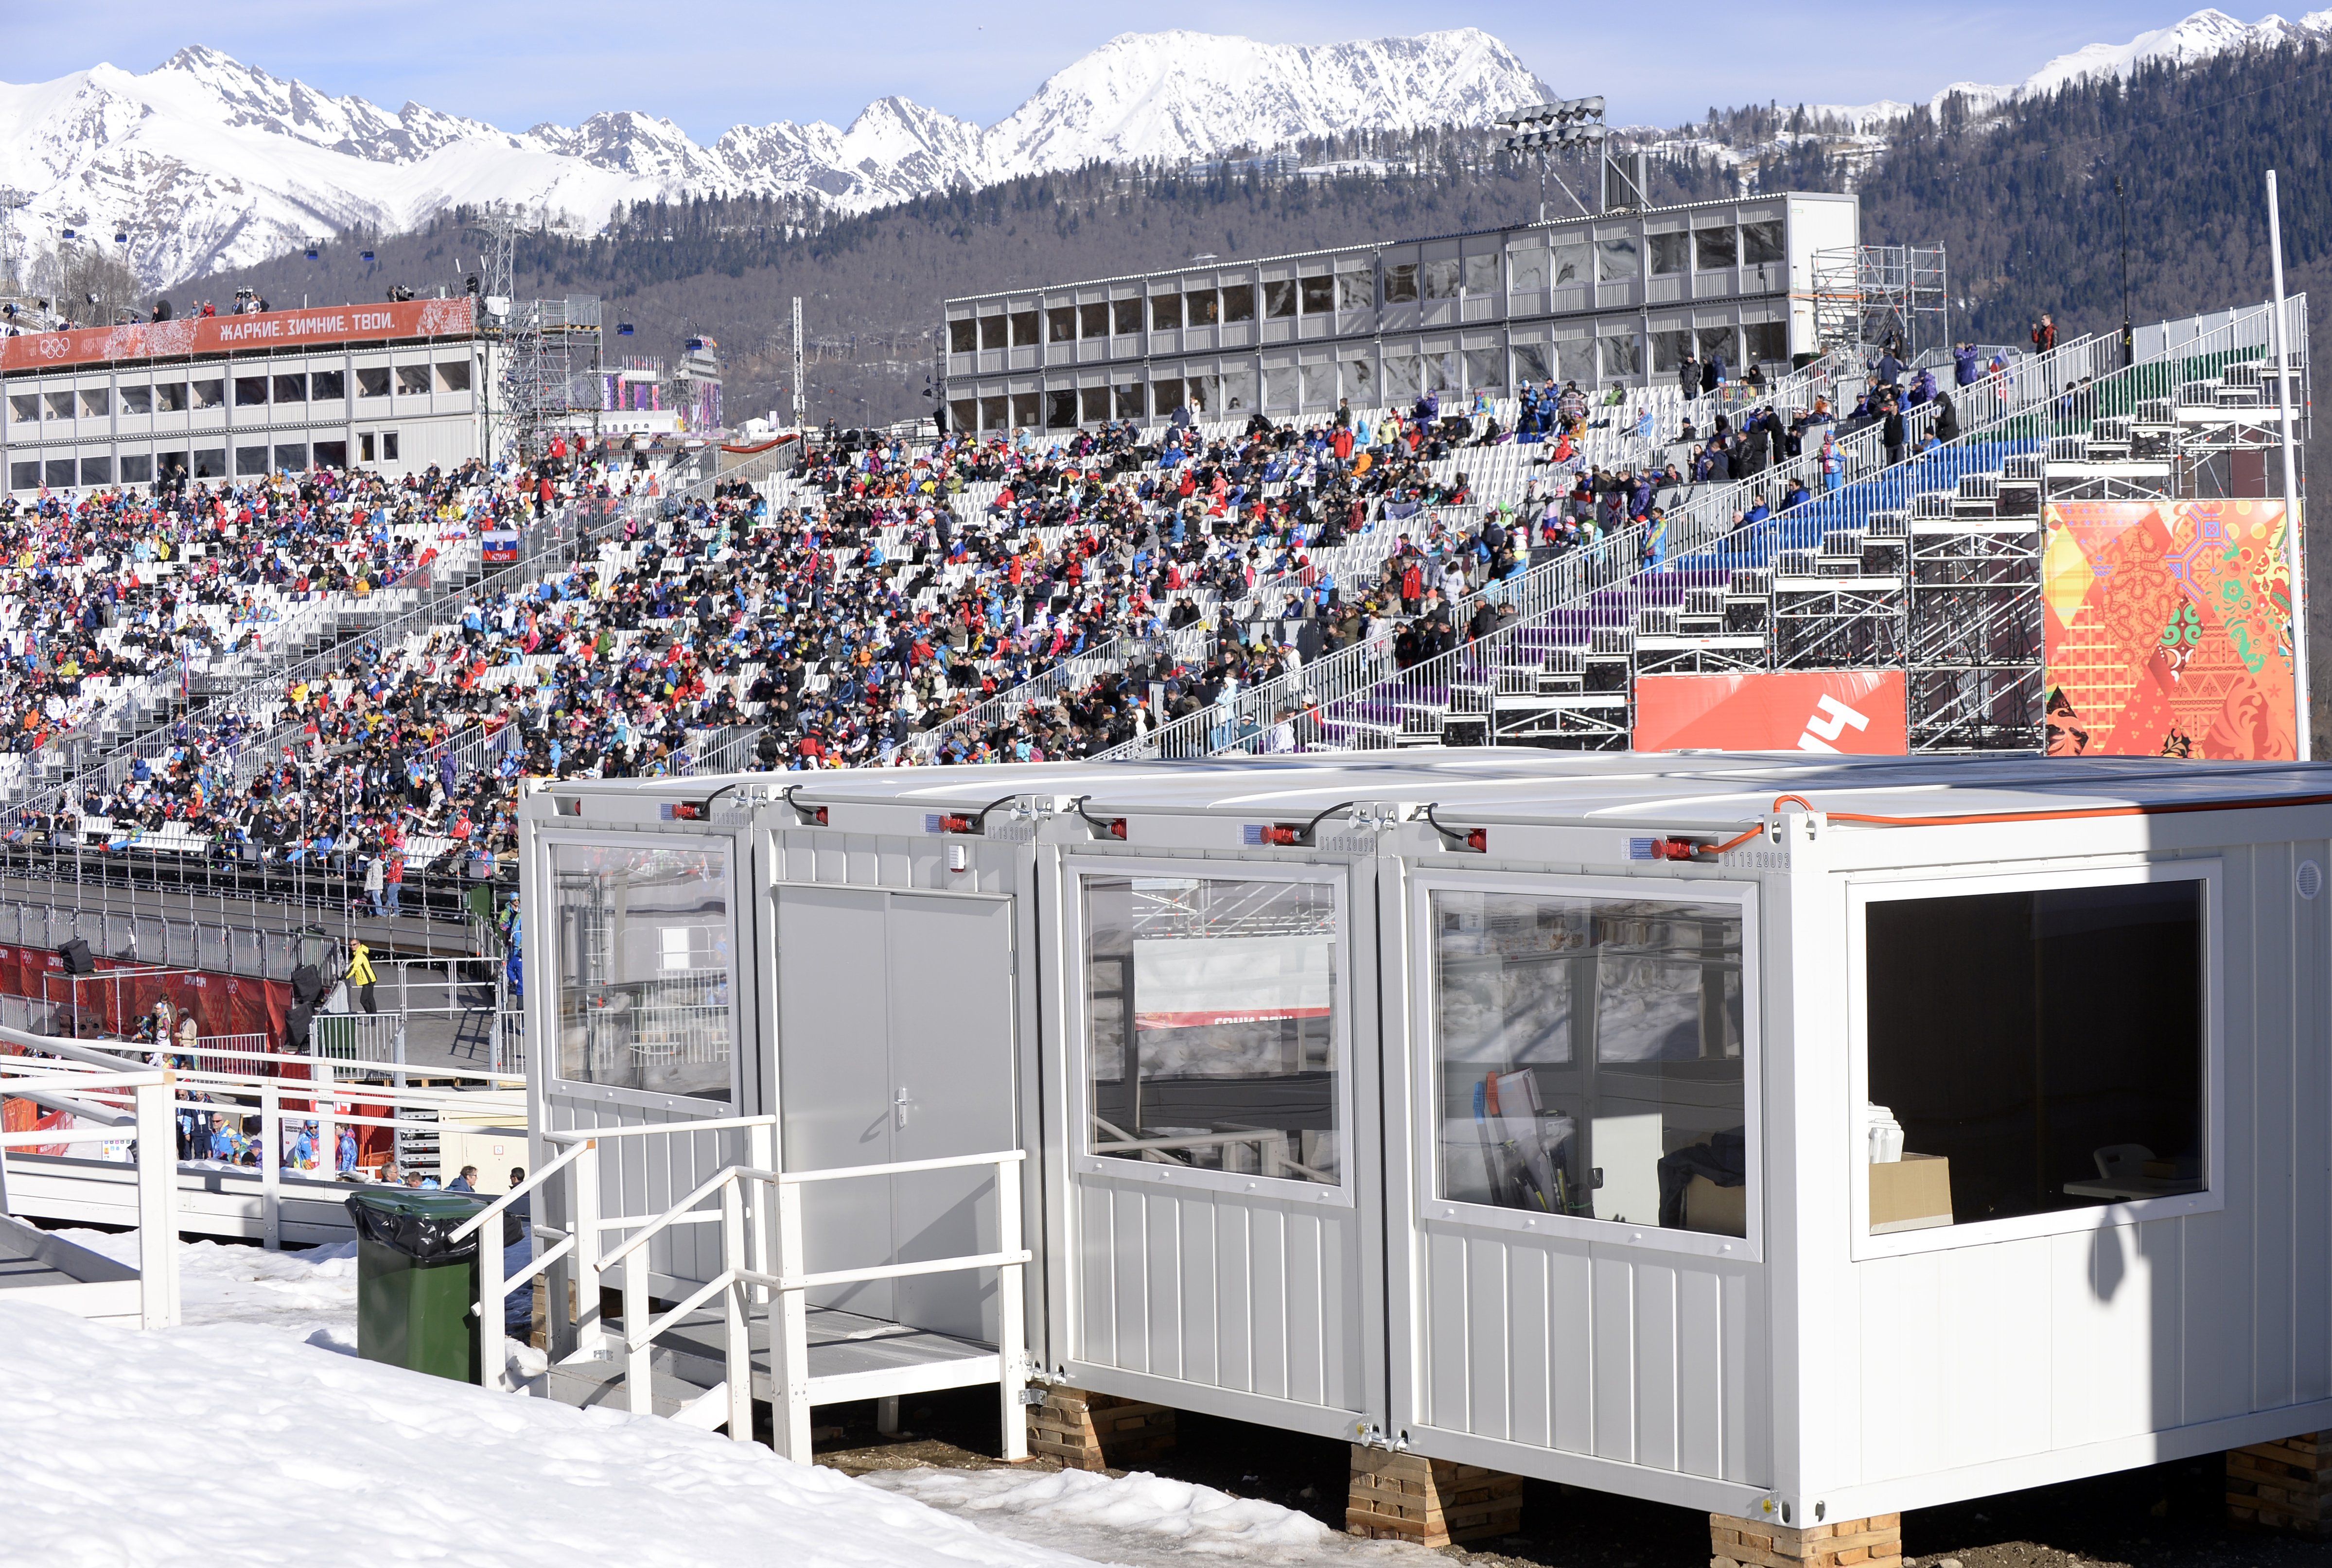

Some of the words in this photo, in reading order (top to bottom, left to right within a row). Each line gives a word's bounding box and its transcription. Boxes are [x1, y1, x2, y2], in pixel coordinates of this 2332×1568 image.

[220, 320, 284, 341] ЖАРКИЕ.
[287, 315, 348, 335] ЗИМНИЕ.
[351, 312, 395, 331] ТВОИ.
[987, 826, 996, 839] 01
[999, 826, 1008, 839] 13
[1010, 827, 1032, 840] 28091
[1320, 836, 1330, 850] 01
[1333, 836, 1343, 851] 13
[1347, 837, 1374, 852] 28092
[1724, 852, 1736, 867] 01
[1740, 852, 1752, 868] 13
[1756, 852, 1790, 869] 28093
